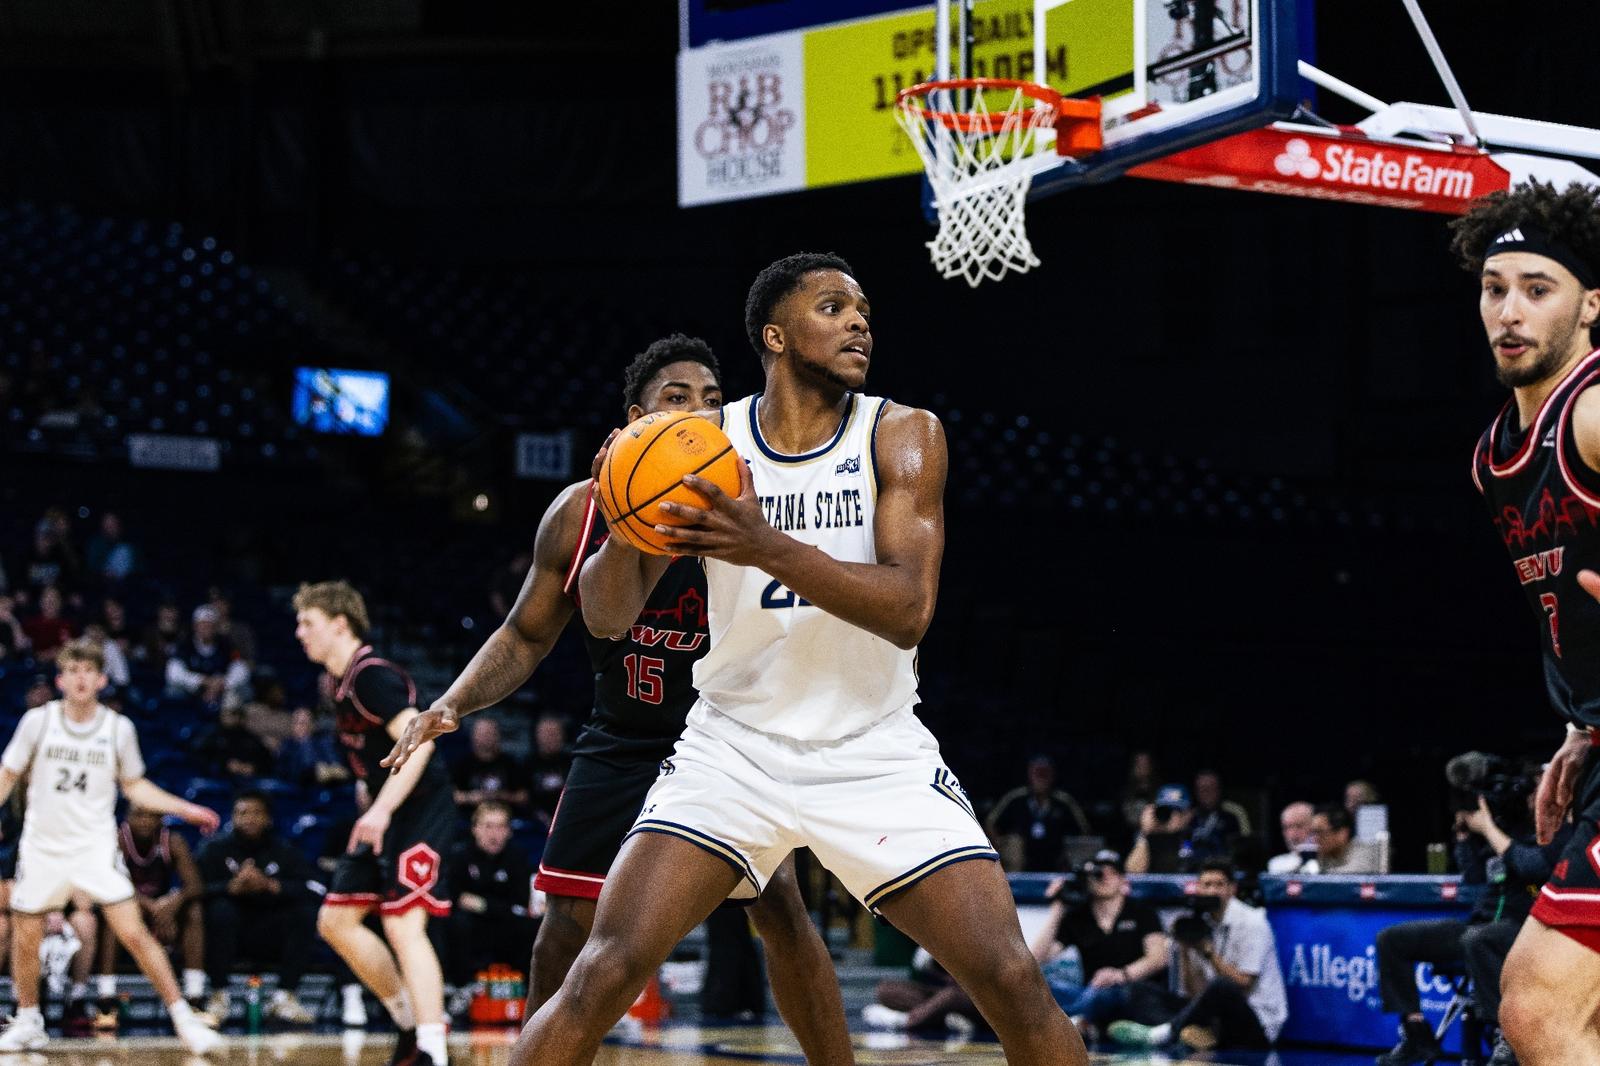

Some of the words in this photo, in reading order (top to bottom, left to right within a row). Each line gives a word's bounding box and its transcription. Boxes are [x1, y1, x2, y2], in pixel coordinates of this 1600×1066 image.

[694, 108, 796, 160] CHOP
[758, 492, 807, 531] TANA
[815, 489, 863, 529] STATE
[623, 653, 665, 705] 15
[55, 767, 88, 794] 24
[1288, 943, 1376, 1001] Allegi
